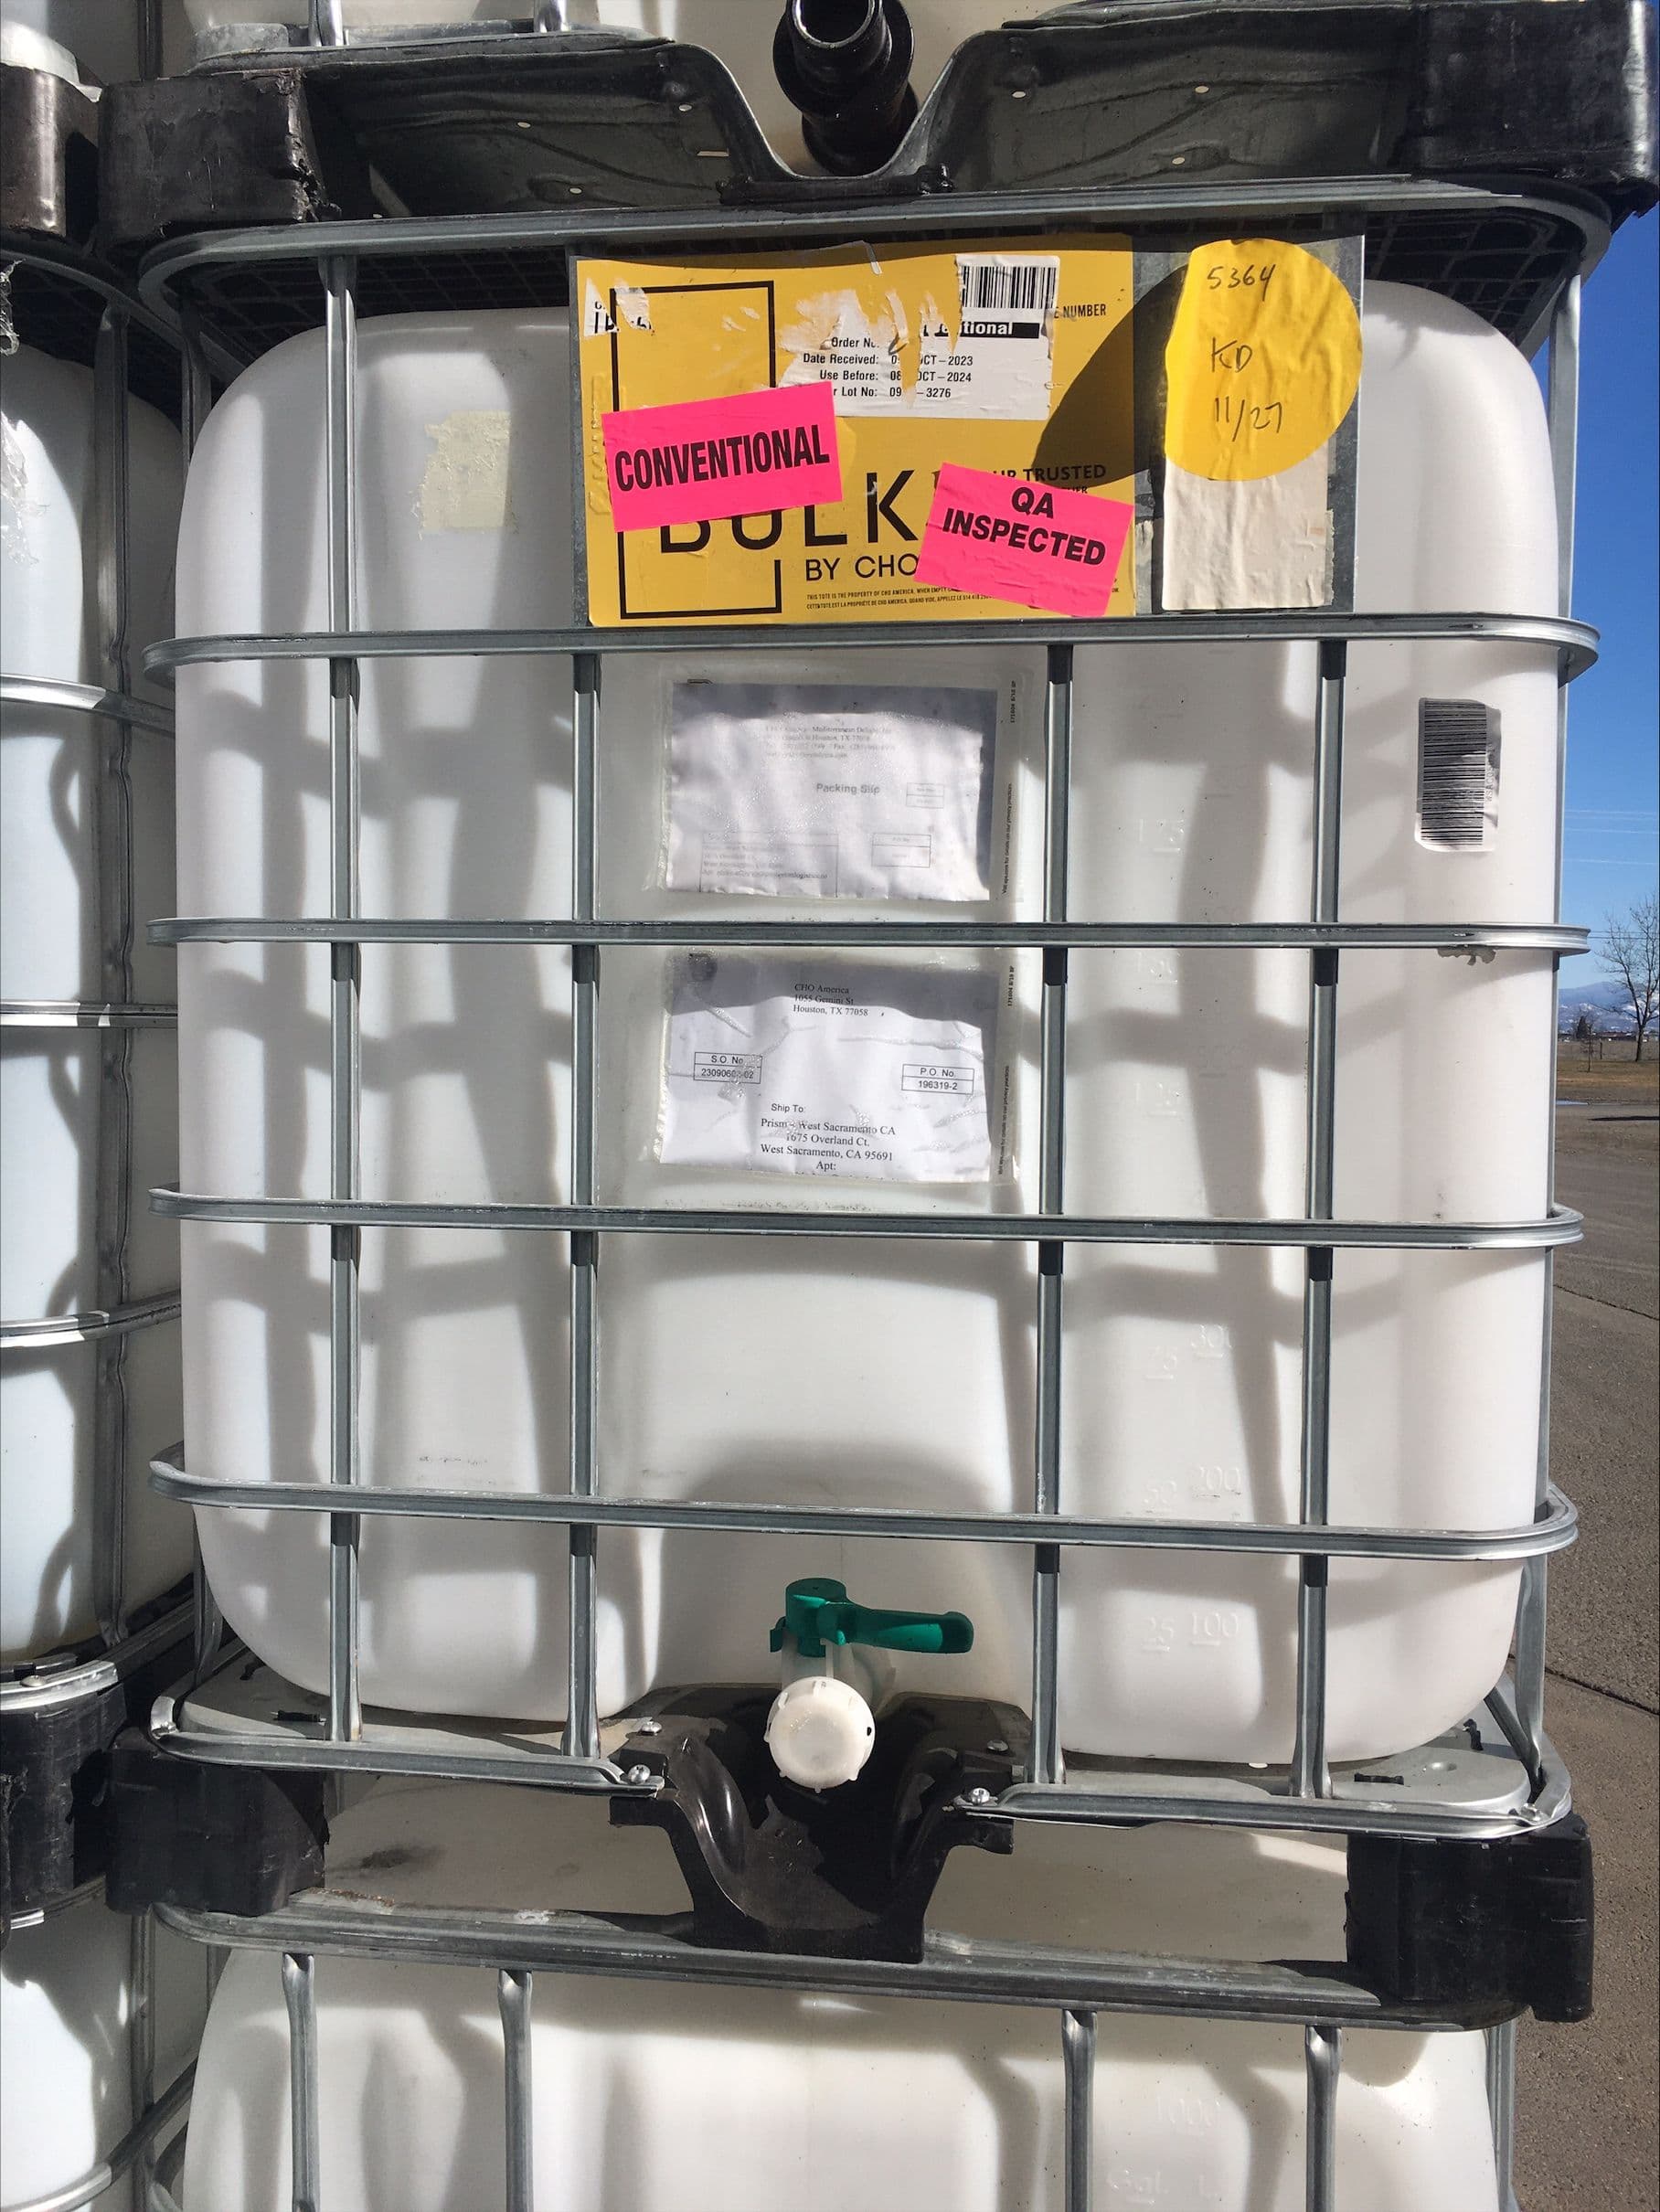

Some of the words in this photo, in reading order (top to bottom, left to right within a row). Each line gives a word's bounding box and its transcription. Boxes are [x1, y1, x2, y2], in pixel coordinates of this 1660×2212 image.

[1206, 263, 1276, 302] 5364
[1062, 303, 1106, 318] NUMBER
[831, 337, 859, 347] Order
[803, 354, 825, 364] Date
[830, 354, 878, 365] Received:
[820, 371, 838, 380] Use
[843, 371, 878, 380] Before:
[842, 387, 858, 397] Lot
[861, 388, 878, 397] No:
[889, 387, 901, 397] 09
[1213, 397, 1283, 442] 11/27
[614, 424, 830, 492] CONVENTIONAL
[1023, 464, 1106, 483] TRUSTED
[1011, 486, 1054, 518] QA
[942, 507, 1106, 566] INSPECTED
[805, 558, 841, 581] BY
[855, 553, 919, 578] CHO
[816, 783, 857, 795] Packing
[860, 784, 880, 795] Slip
[794, 984, 814, 992] CHO
[817, 985, 849, 994] America
[794, 994, 813, 1003] 1055
[793, 1005, 827, 1015] Houston,
[846, 1007, 868, 1016] 77058
[919, 1080, 958, 1090] 196319-2
[771, 1102, 790, 1113] Ship
[761, 1118, 787, 1128] Prism
[799, 1121, 821, 1130] West
[824, 1122, 878, 1134] Sacramento
[879, 1126, 896, 1135] CA
[786, 1133, 807, 1142] 1675
[811, 1134, 853, 1145] Overland
[857, 1137, 870, 1146] Ct.
[761, 1144, 783, 1154] West
[787, 1146, 843, 1159] Sacramento,
[846, 1150, 861, 1159] CA
[865, 1151, 892, 1161] 95691
[816, 1161, 836, 1172] Apt:
